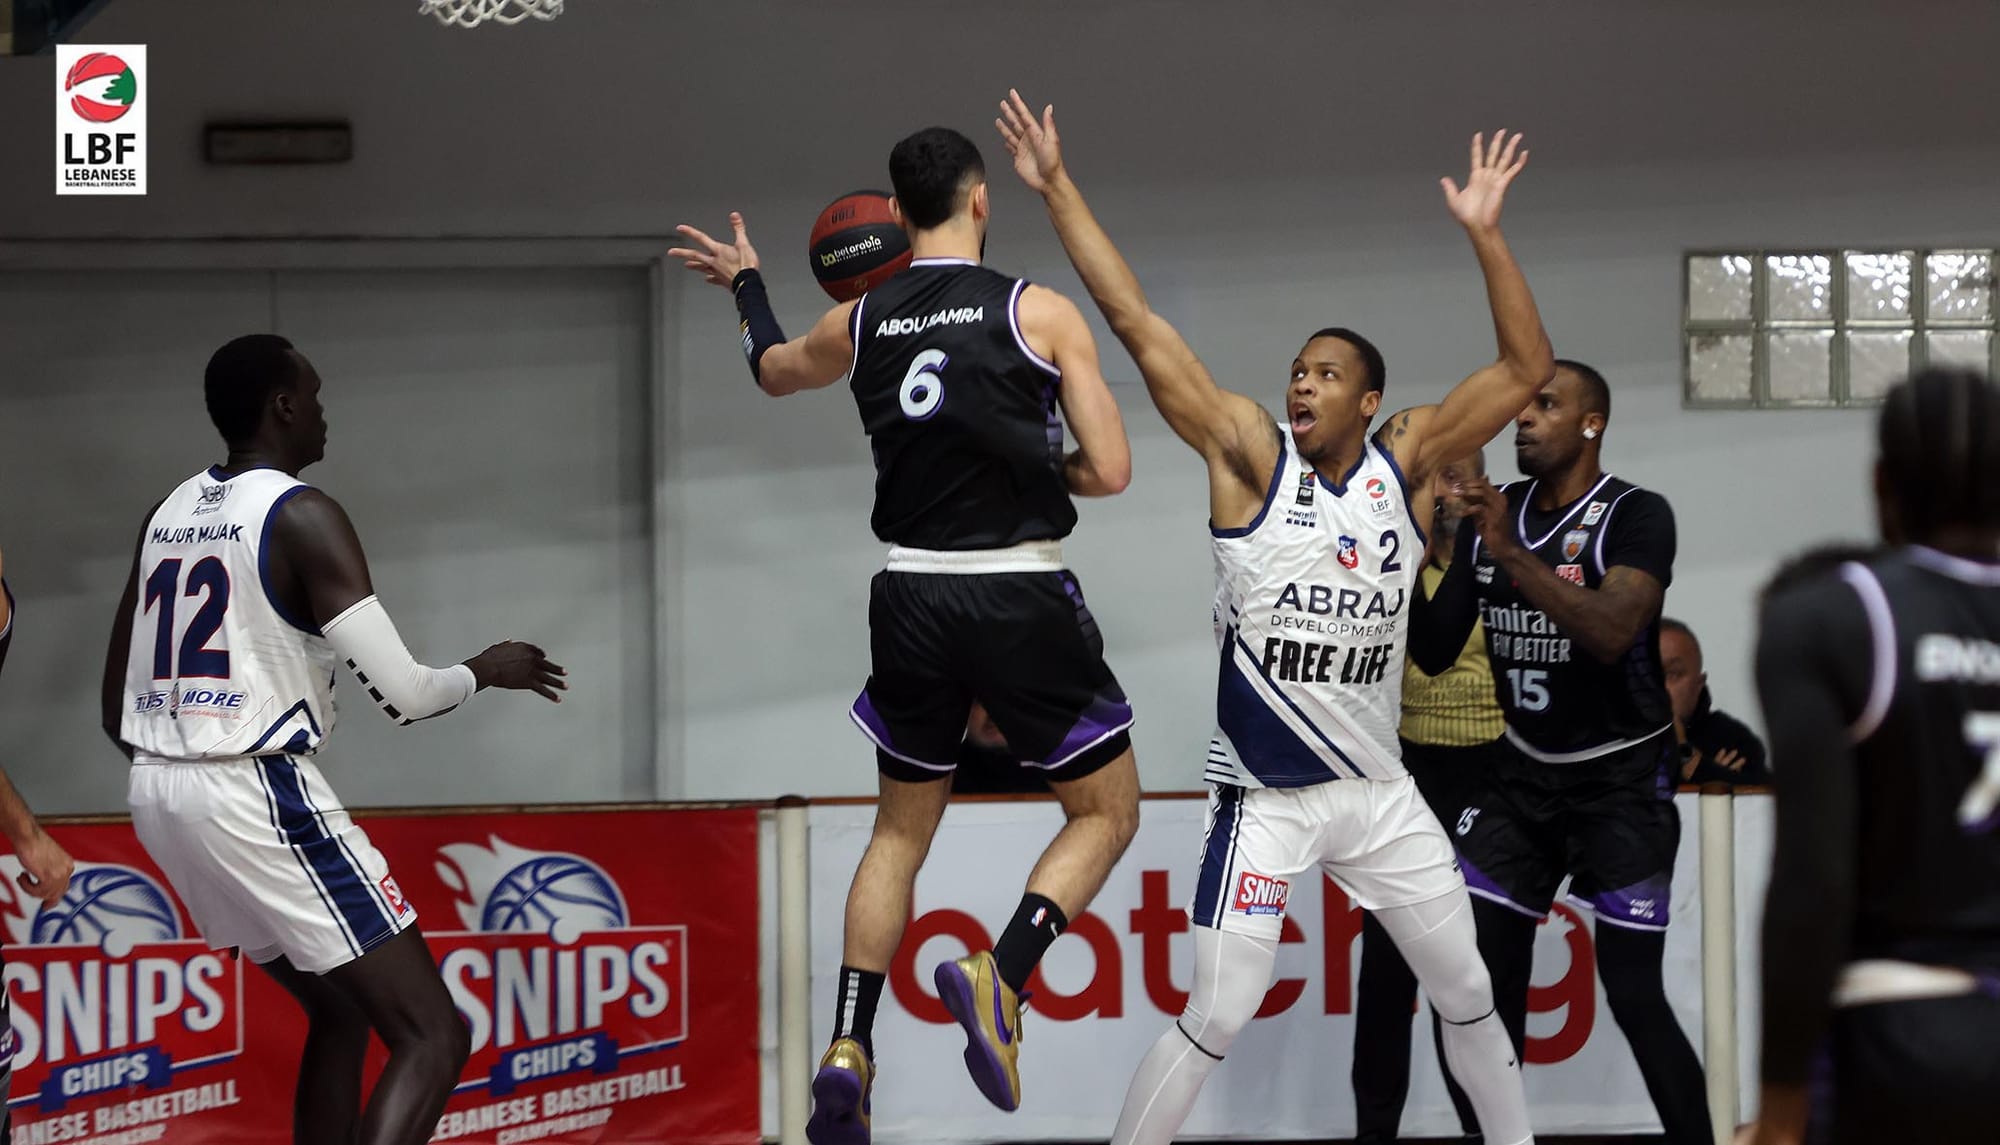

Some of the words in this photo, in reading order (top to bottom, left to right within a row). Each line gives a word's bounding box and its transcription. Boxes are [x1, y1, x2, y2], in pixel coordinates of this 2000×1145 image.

[875, 316, 928, 338] ABOU
[899, 348, 949, 421] 6
[1370, 499, 1391, 514] LBF
[151, 526, 195, 545] MAJUR
[1379, 529, 1401, 574] 2
[143, 555, 231, 680] 12
[1273, 582, 1405, 619] ABRAJ
[1270, 614, 1396, 638] DEVELOPMENTS
[1263, 636, 1339, 683] FREE
[1513, 636, 1572, 663] BETTER
[181, 688, 246, 709] MORE
[1506, 668, 1552, 712] 15
[61, 1052, 150, 1097] CHIPS
[511, 1038, 597, 1082] CHIPS
[94, 1079, 241, 1132] BASKETBALL
[429, 1096, 540, 1144] EBANESE
[542, 1065, 686, 1118] BASKETBALL
